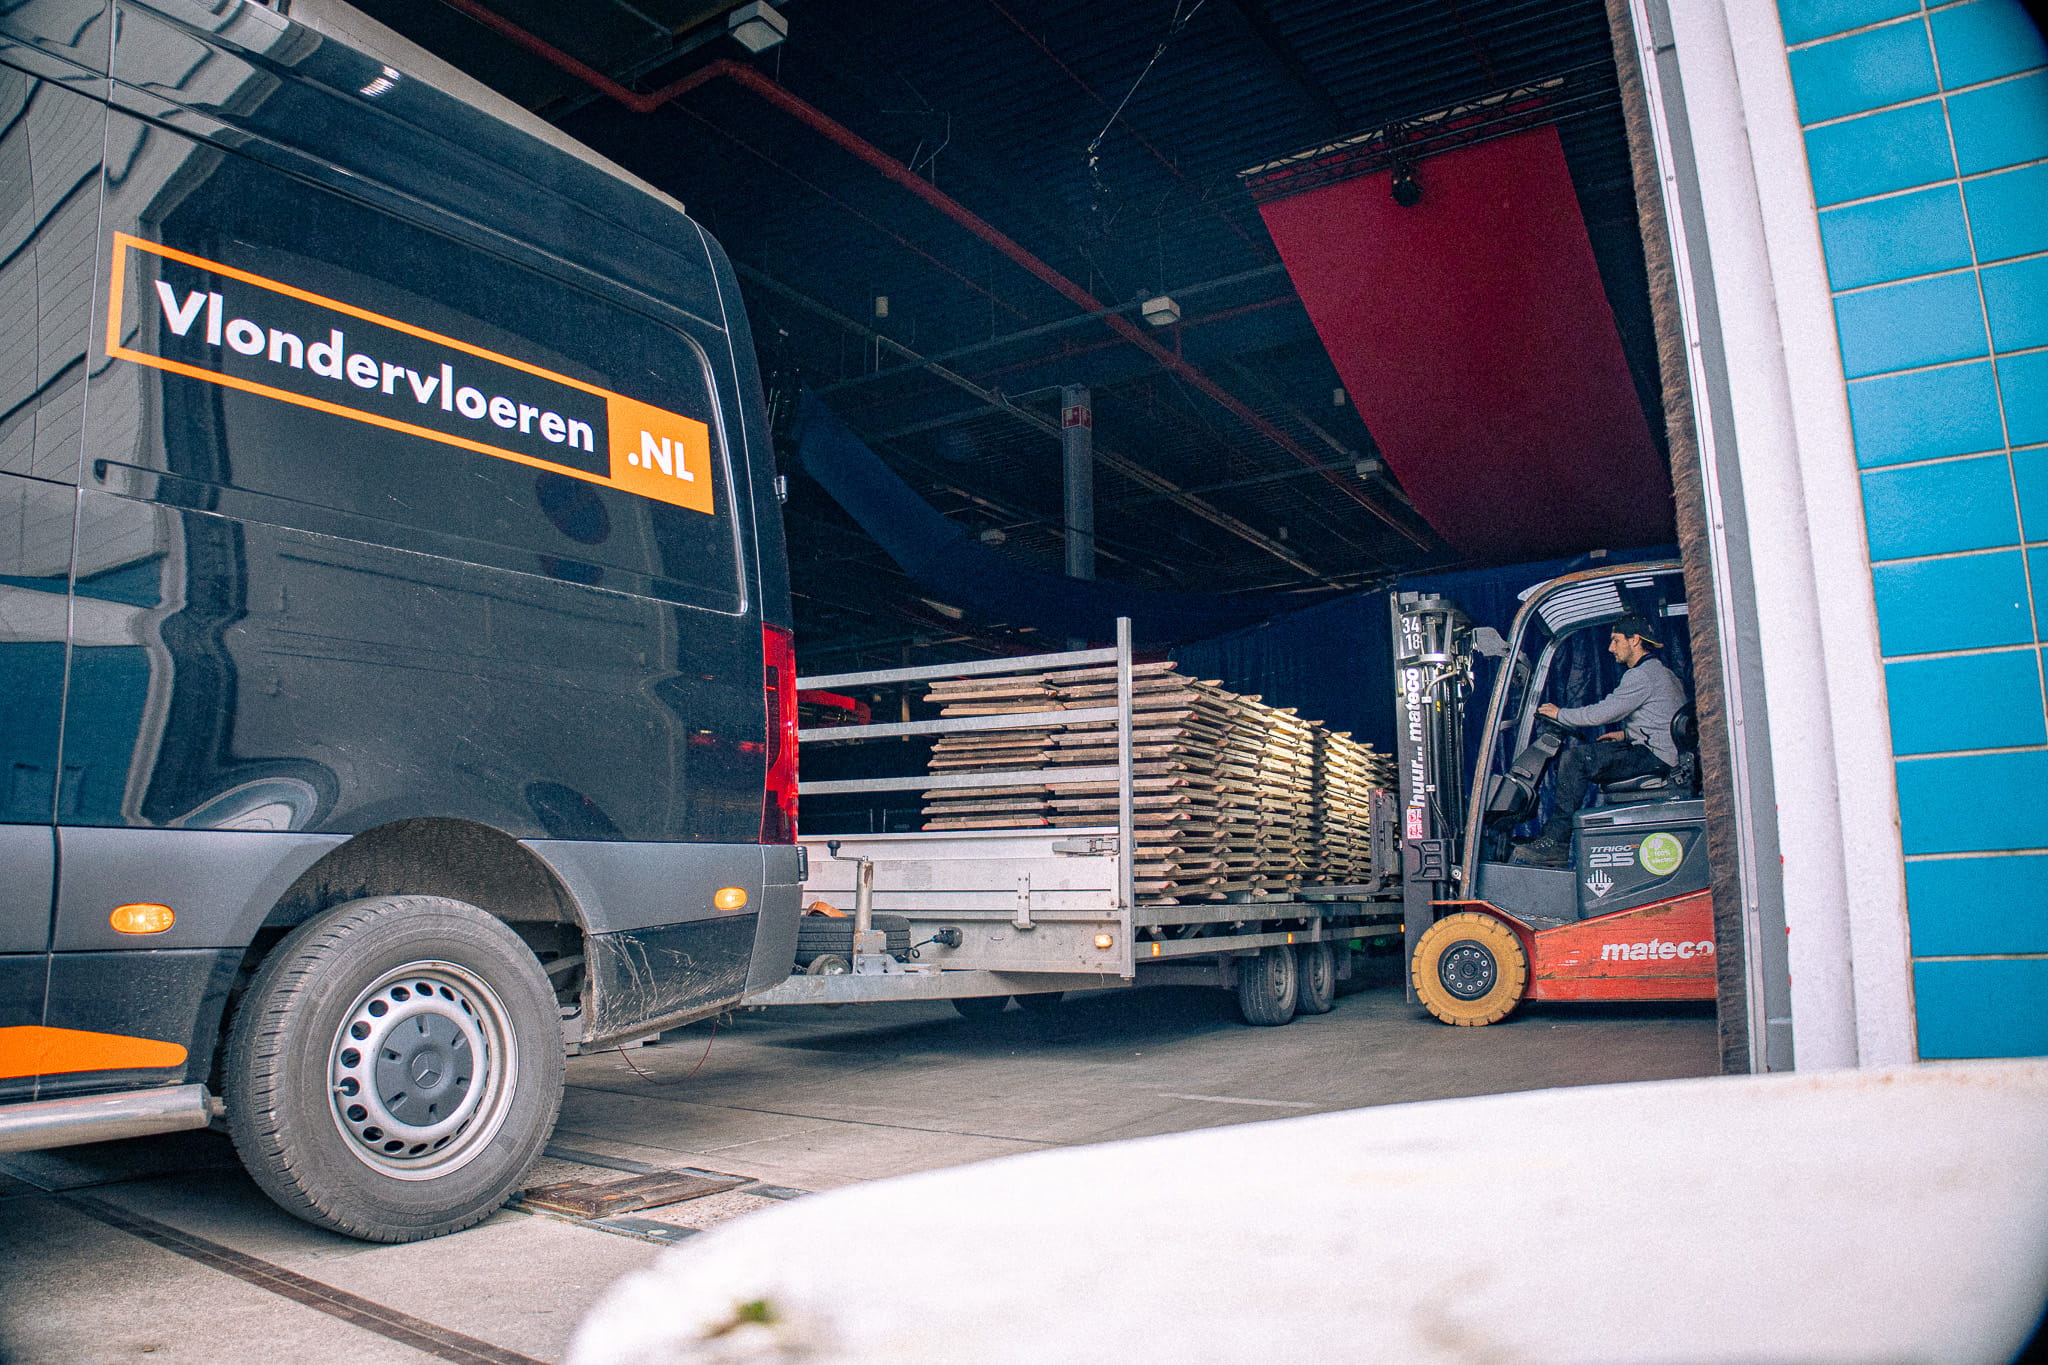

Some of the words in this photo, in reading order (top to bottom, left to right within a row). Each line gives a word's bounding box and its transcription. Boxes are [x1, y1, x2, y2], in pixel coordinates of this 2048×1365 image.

[154, 279, 594, 453] Vlondervloeren
[627, 430, 694, 482] .NL
[1402, 616, 1420, 634] 34
[1405, 633, 1420, 650] 18
[1405, 667, 1423, 742] mateco
[1589, 852, 1635, 868] 25
[1600, 938, 1715, 961] mateco
